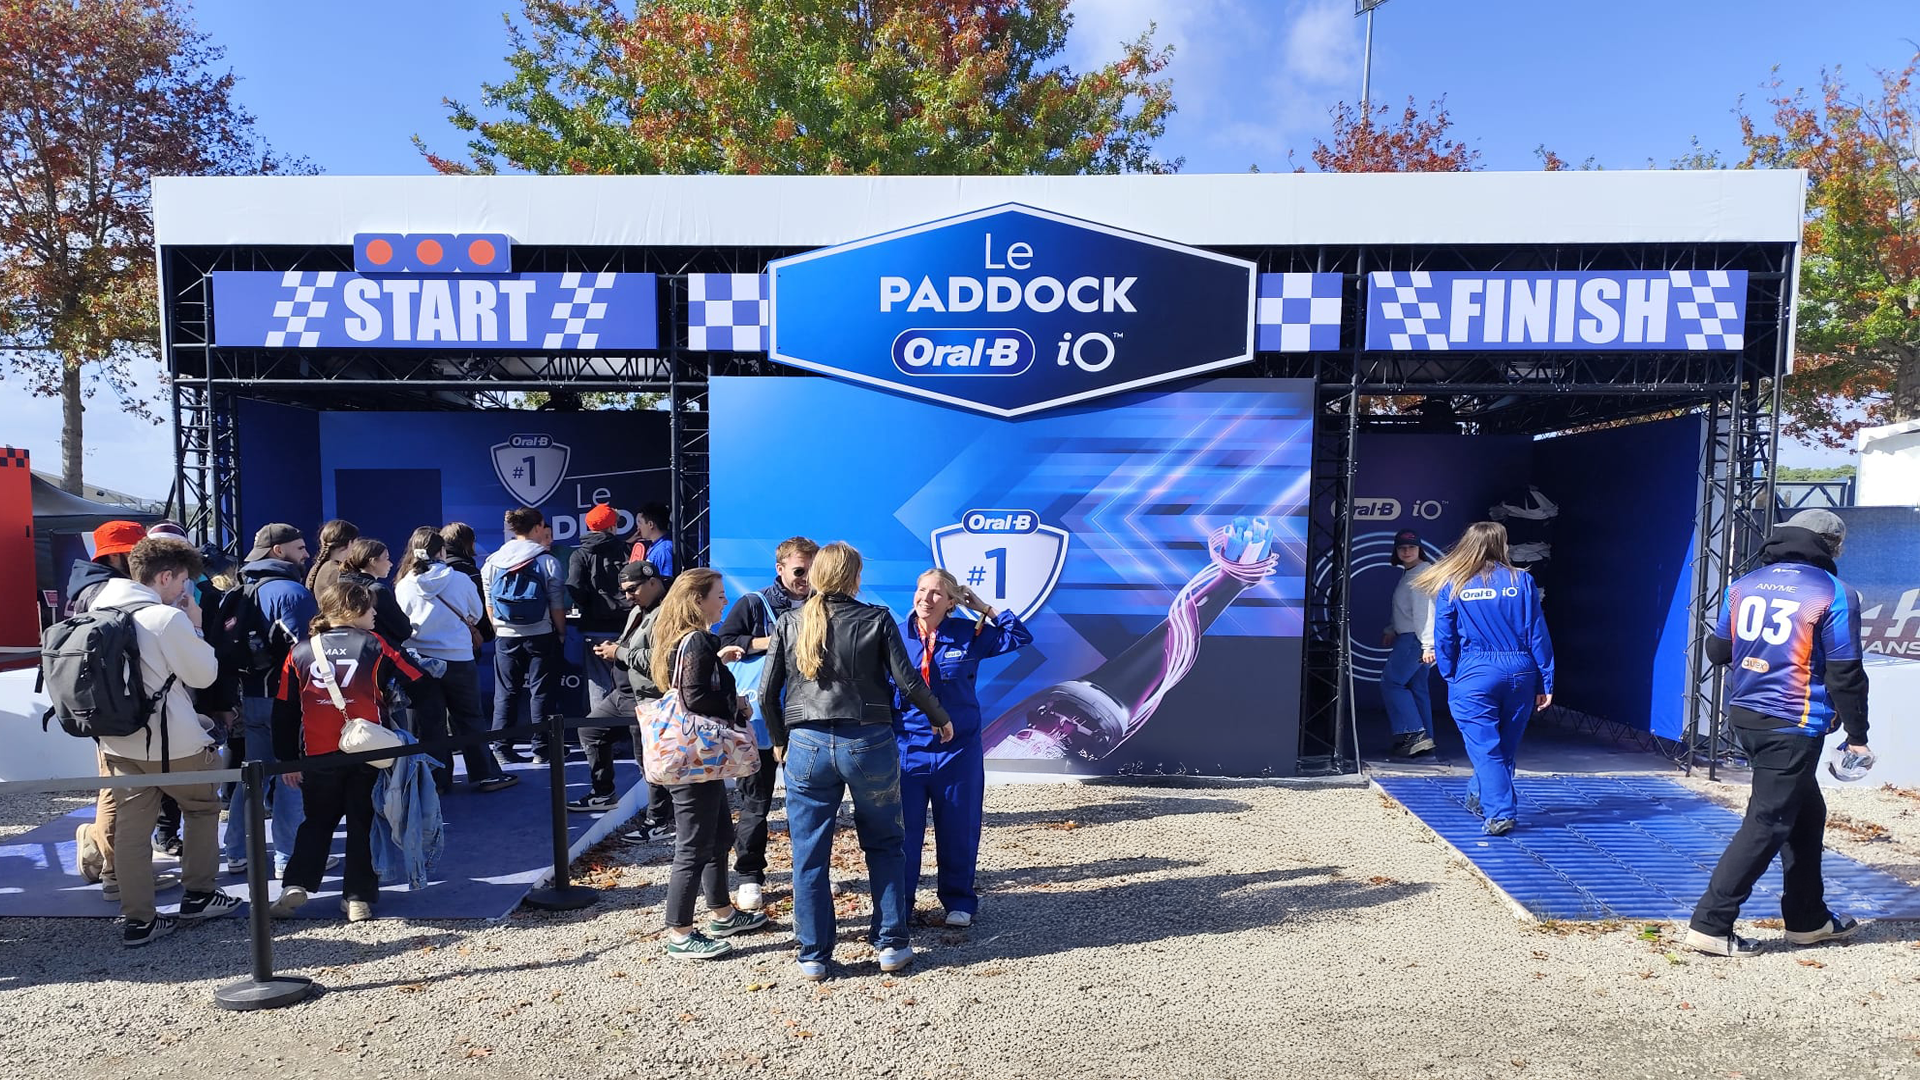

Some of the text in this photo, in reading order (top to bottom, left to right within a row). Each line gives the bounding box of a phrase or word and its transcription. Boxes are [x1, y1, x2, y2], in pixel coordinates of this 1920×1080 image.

[985, 232, 1034, 270] Le
[880, 274, 1138, 313] PADDOCK
[343, 278, 537, 342] START
[1449, 277, 1670, 344] FINISH
[903, 337, 1020, 367] Oral-B
[512, 436, 549, 446] Oral-B
[512, 455, 536, 487] #1
[576, 483, 611, 508] Le
[1352, 502, 1394, 516] ral-B
[968, 514, 1031, 531] Oral-B
[966, 547, 1007, 600] #1
[1755, 583, 1799, 594] ANYME
[1462, 589, 1493, 600] Oral-B
[1737, 595, 1802, 645] 03
[324, 648, 347, 656] MAX
[1861, 640, 1920, 655] ANS
[309, 659, 359, 689] 97
